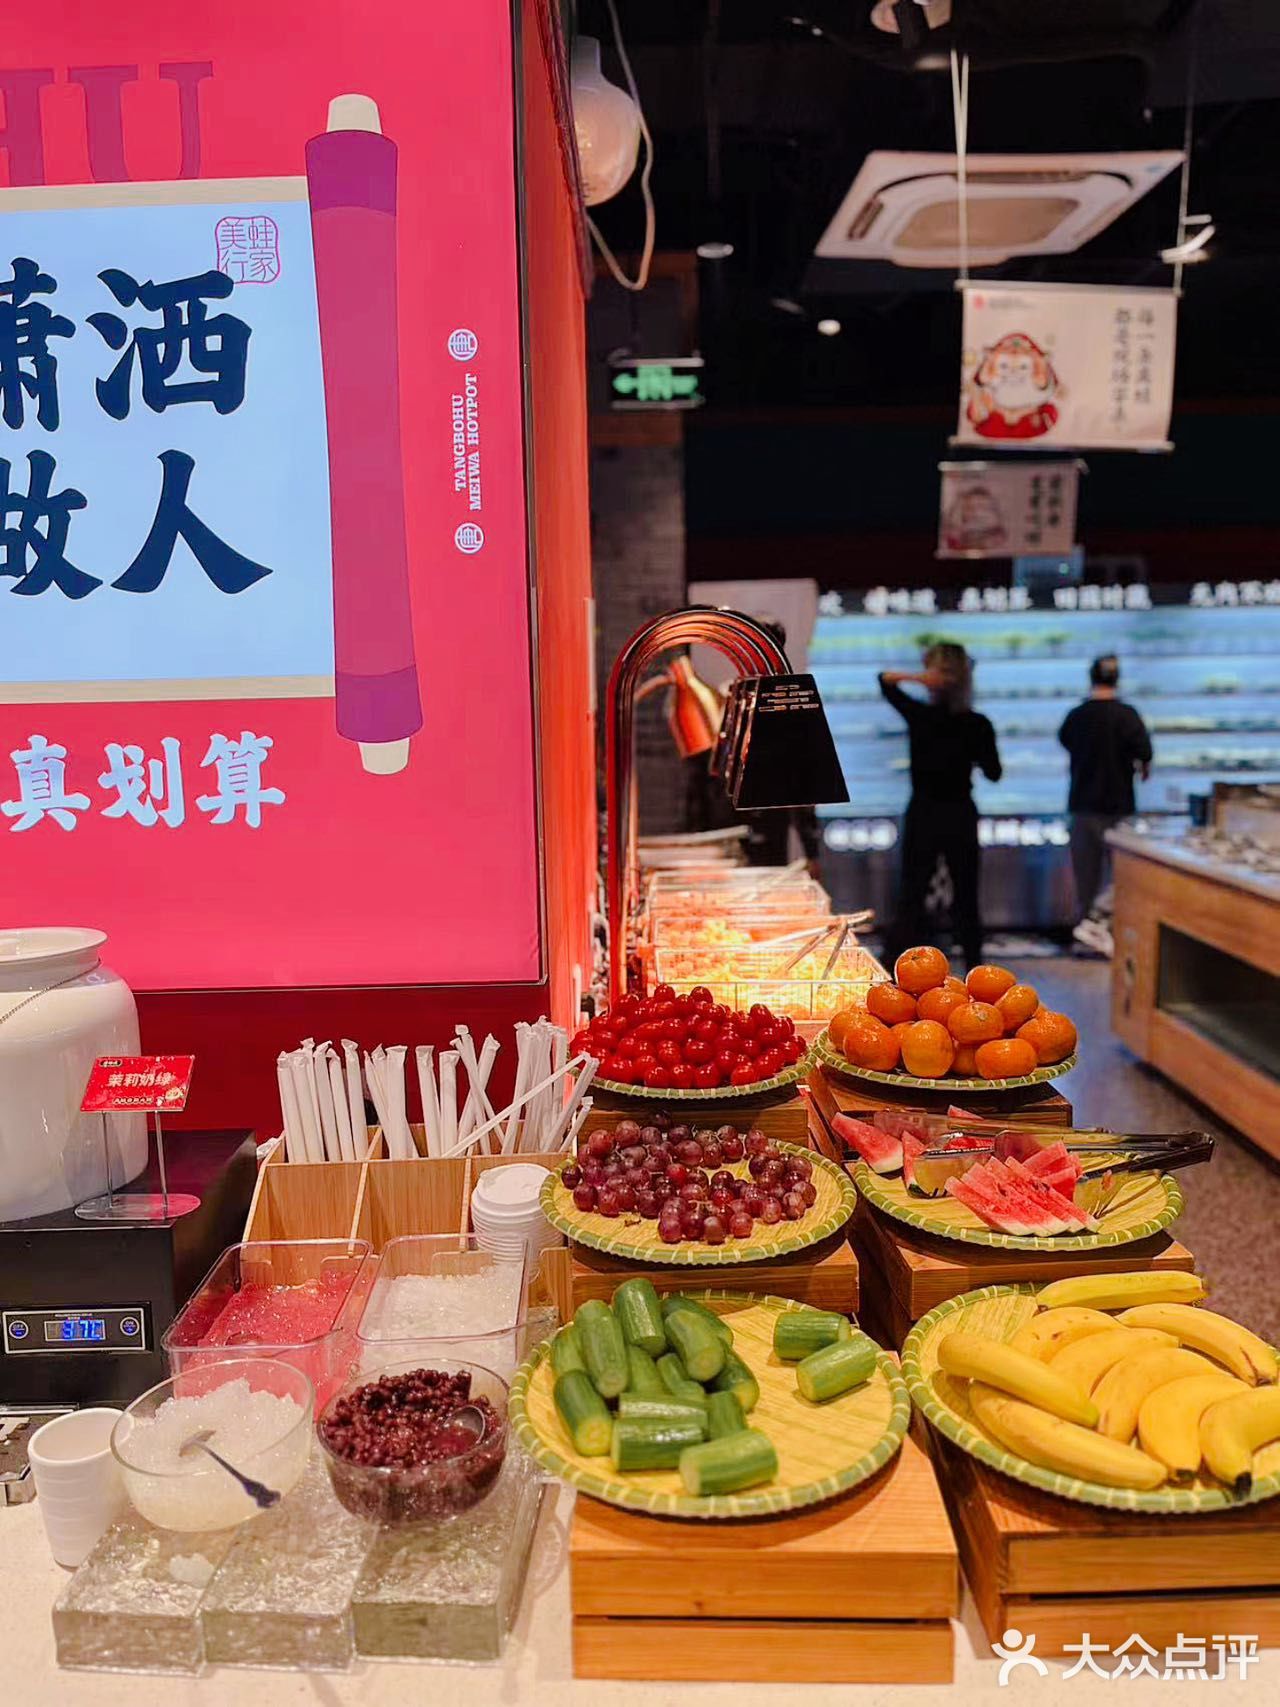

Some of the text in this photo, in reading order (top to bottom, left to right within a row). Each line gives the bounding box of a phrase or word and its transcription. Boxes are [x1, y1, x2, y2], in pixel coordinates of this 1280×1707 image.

[452, 394, 467, 491] TANGBOHU
[465, 373, 481, 511] MEIWA HOTPOT
[0, 731, 286, 832] 真划算
